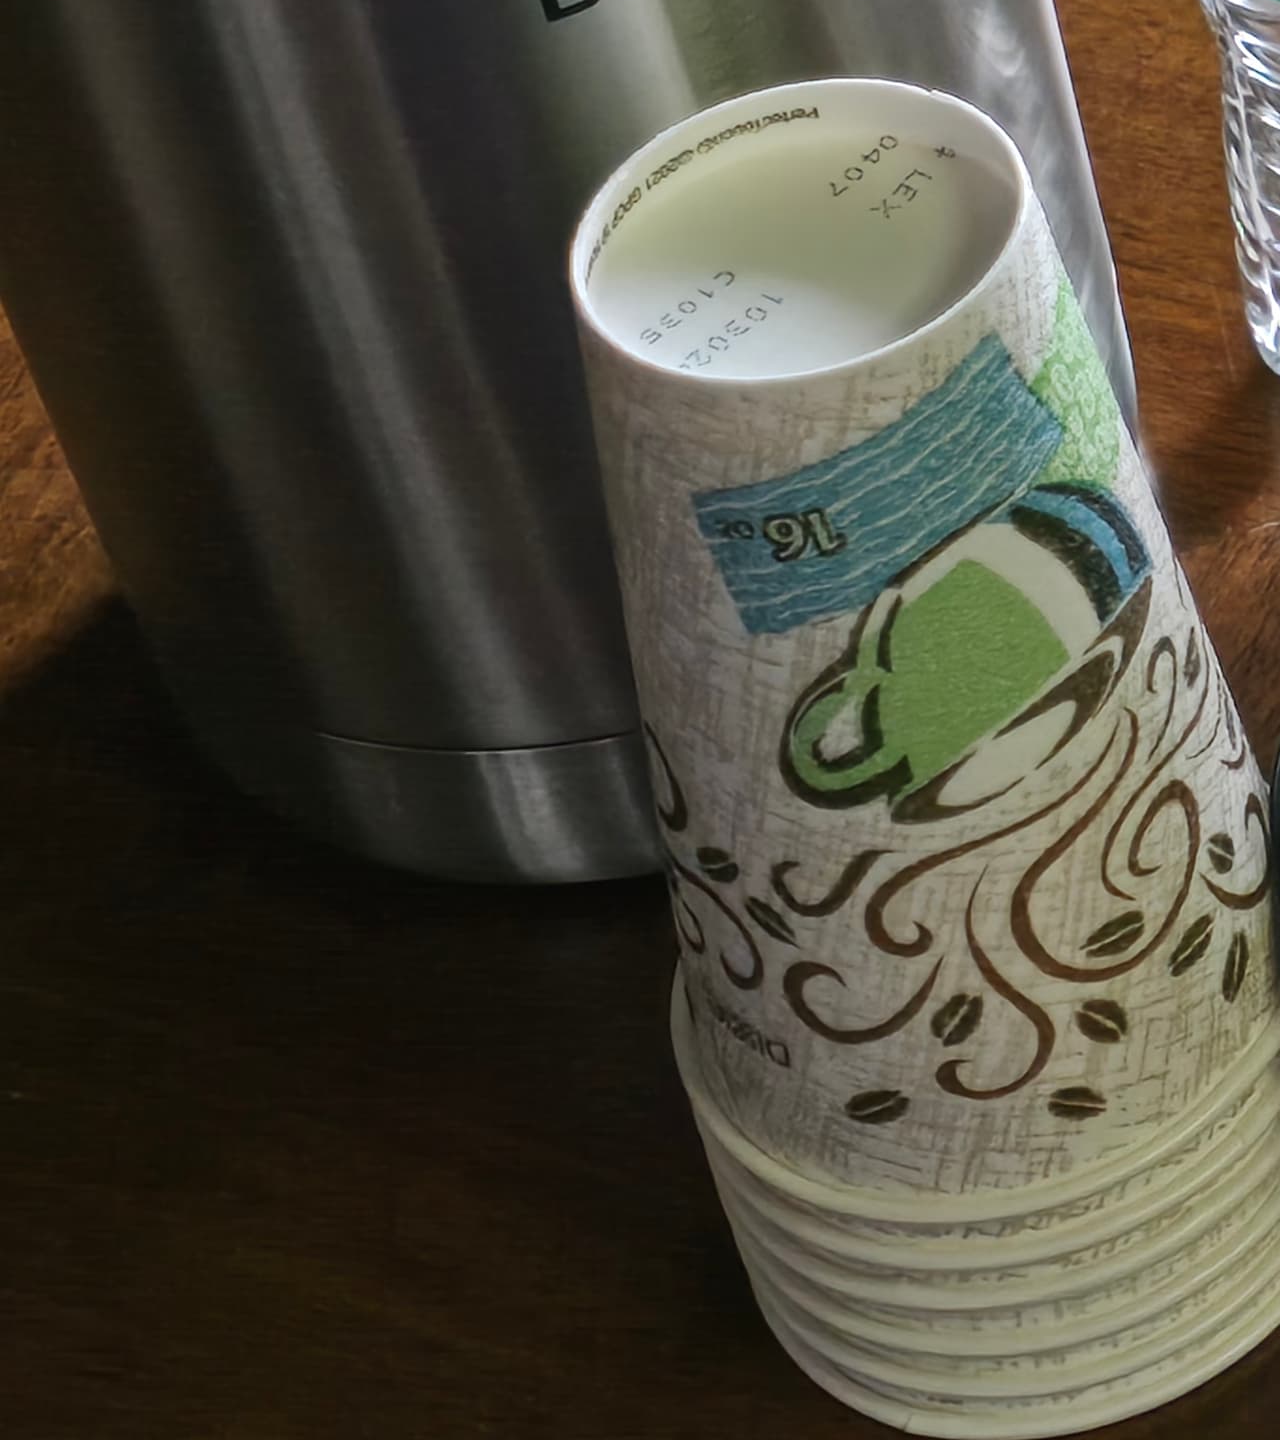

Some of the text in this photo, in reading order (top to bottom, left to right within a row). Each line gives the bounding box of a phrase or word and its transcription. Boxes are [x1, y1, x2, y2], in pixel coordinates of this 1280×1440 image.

[829, 134, 899, 198] 0407
[870, 168, 933, 219] LEX
[762, 506, 848, 563] 16
